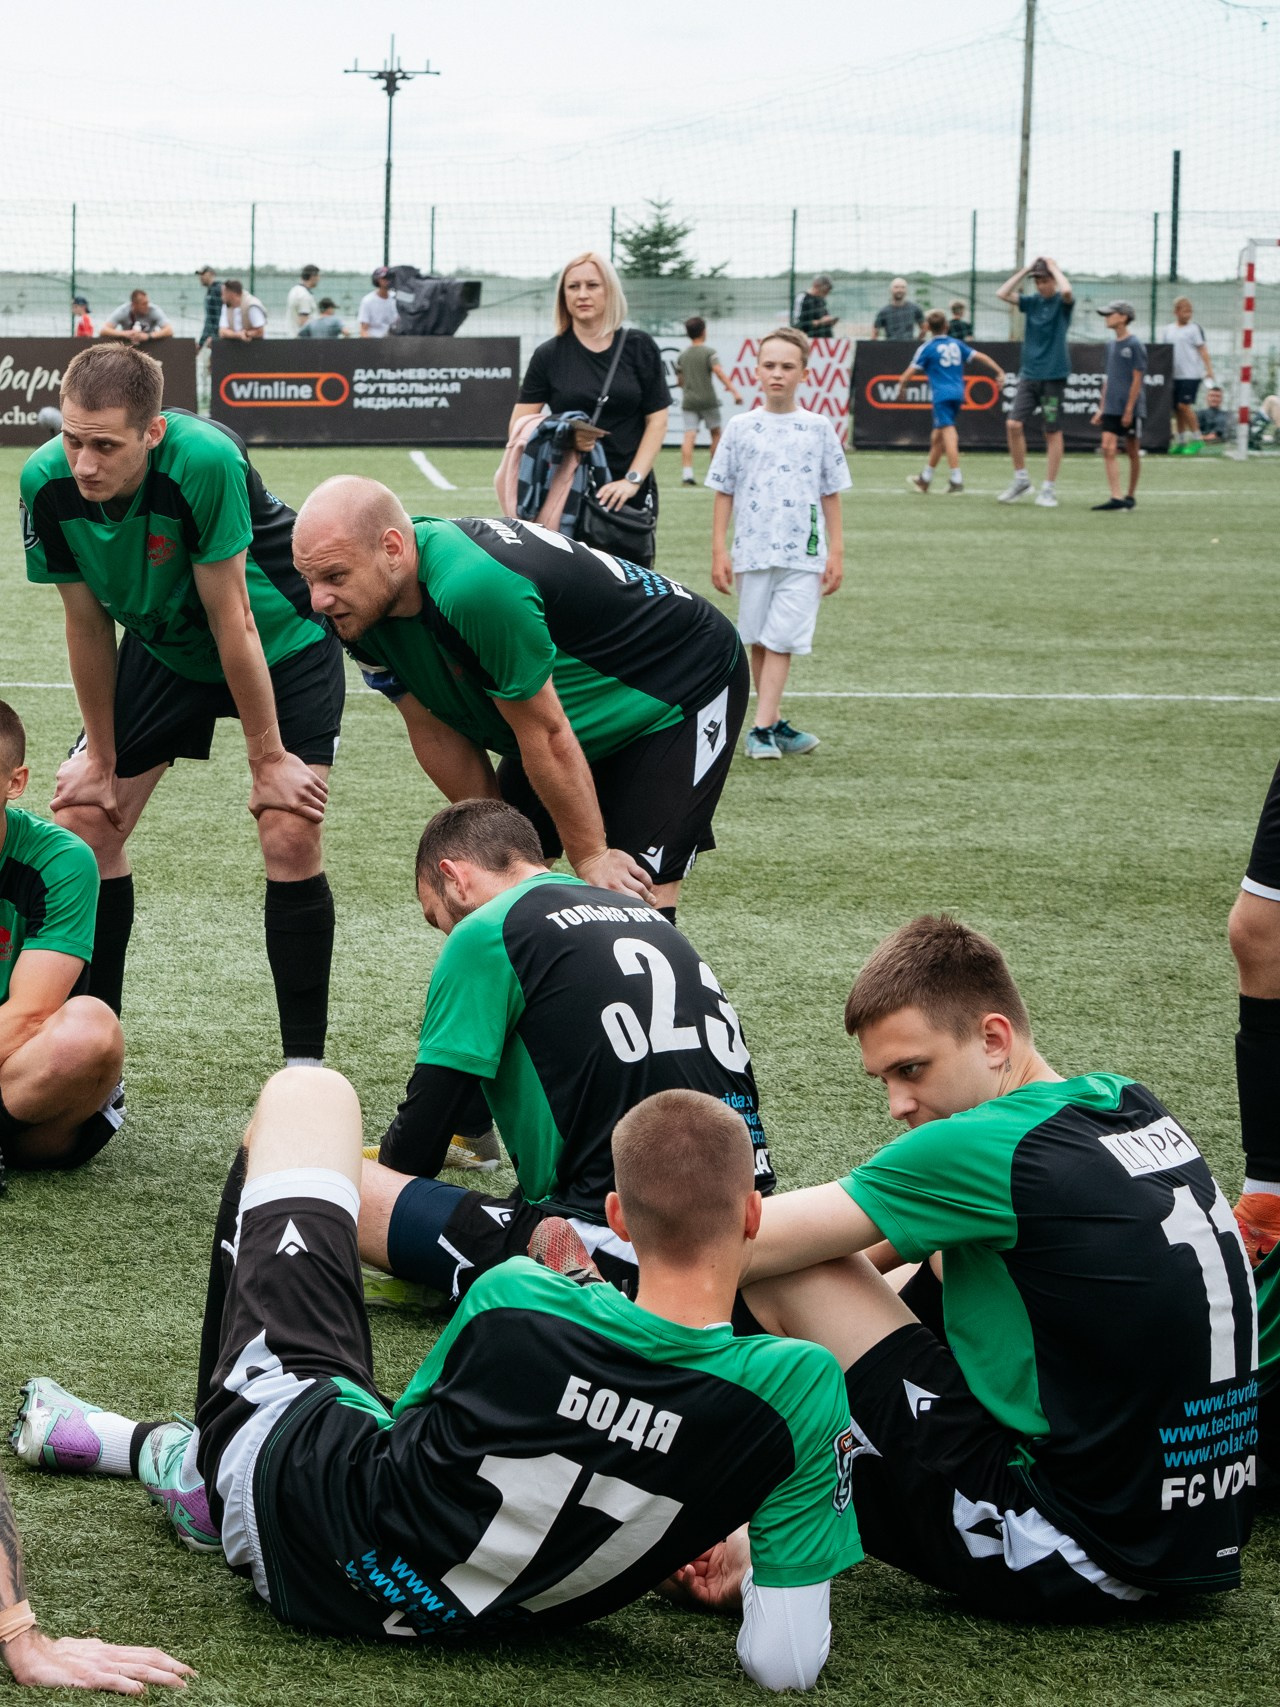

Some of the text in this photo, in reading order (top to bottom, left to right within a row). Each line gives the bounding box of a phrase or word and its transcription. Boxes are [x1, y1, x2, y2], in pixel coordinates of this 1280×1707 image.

[936, 342, 962, 367] 39
[353, 367, 512, 382] ДАЛЬНЕВОСТОЧНАЯ
[231, 381, 313, 399] Winline
[353, 382, 462, 394] ФУТБОЛЬНАЯ
[353, 397, 450, 410] МЕДИАЛИГА
[1160, 1176, 1259, 1384] 11
[556, 1374, 684, 1455] БОДЯ
[1161, 1473, 1207, 1511] FC
[440, 1451, 684, 1617] 17
